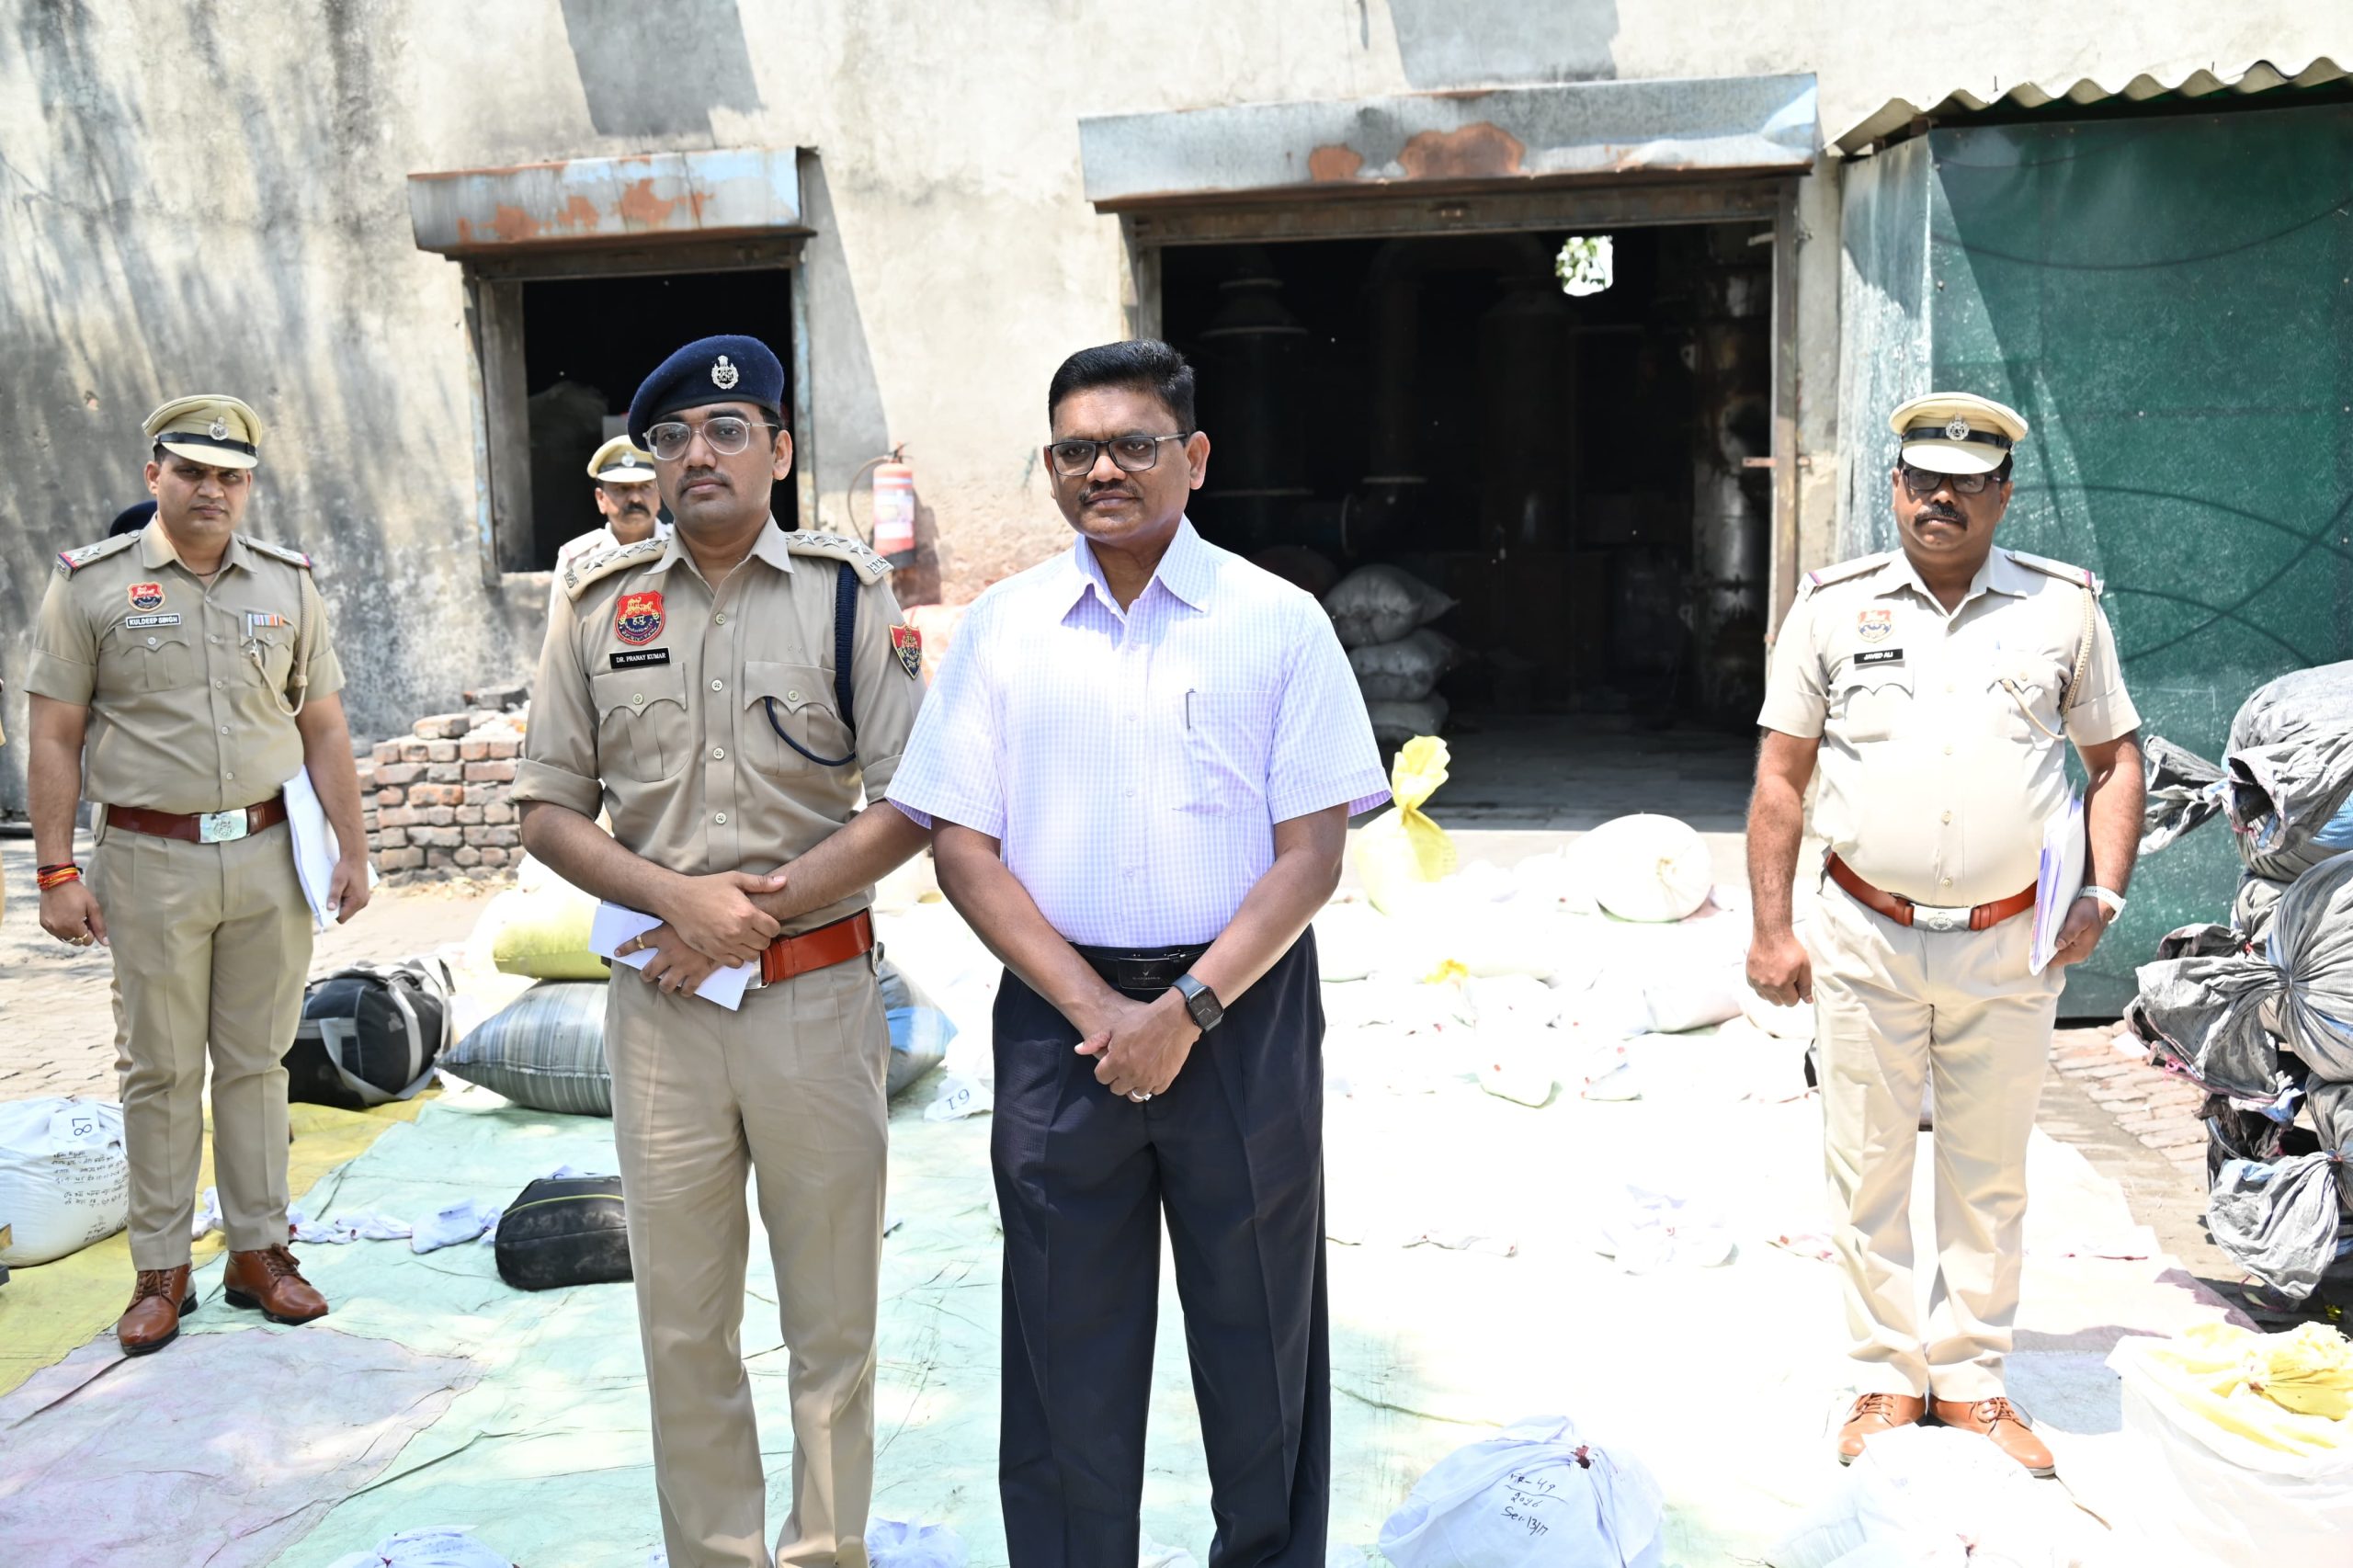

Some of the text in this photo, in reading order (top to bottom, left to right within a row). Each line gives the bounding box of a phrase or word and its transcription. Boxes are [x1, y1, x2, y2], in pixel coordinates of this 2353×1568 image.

[129, 615, 178, 626] KULDEEP SINGH
[1863, 651, 1893, 661] JAVED ALI
